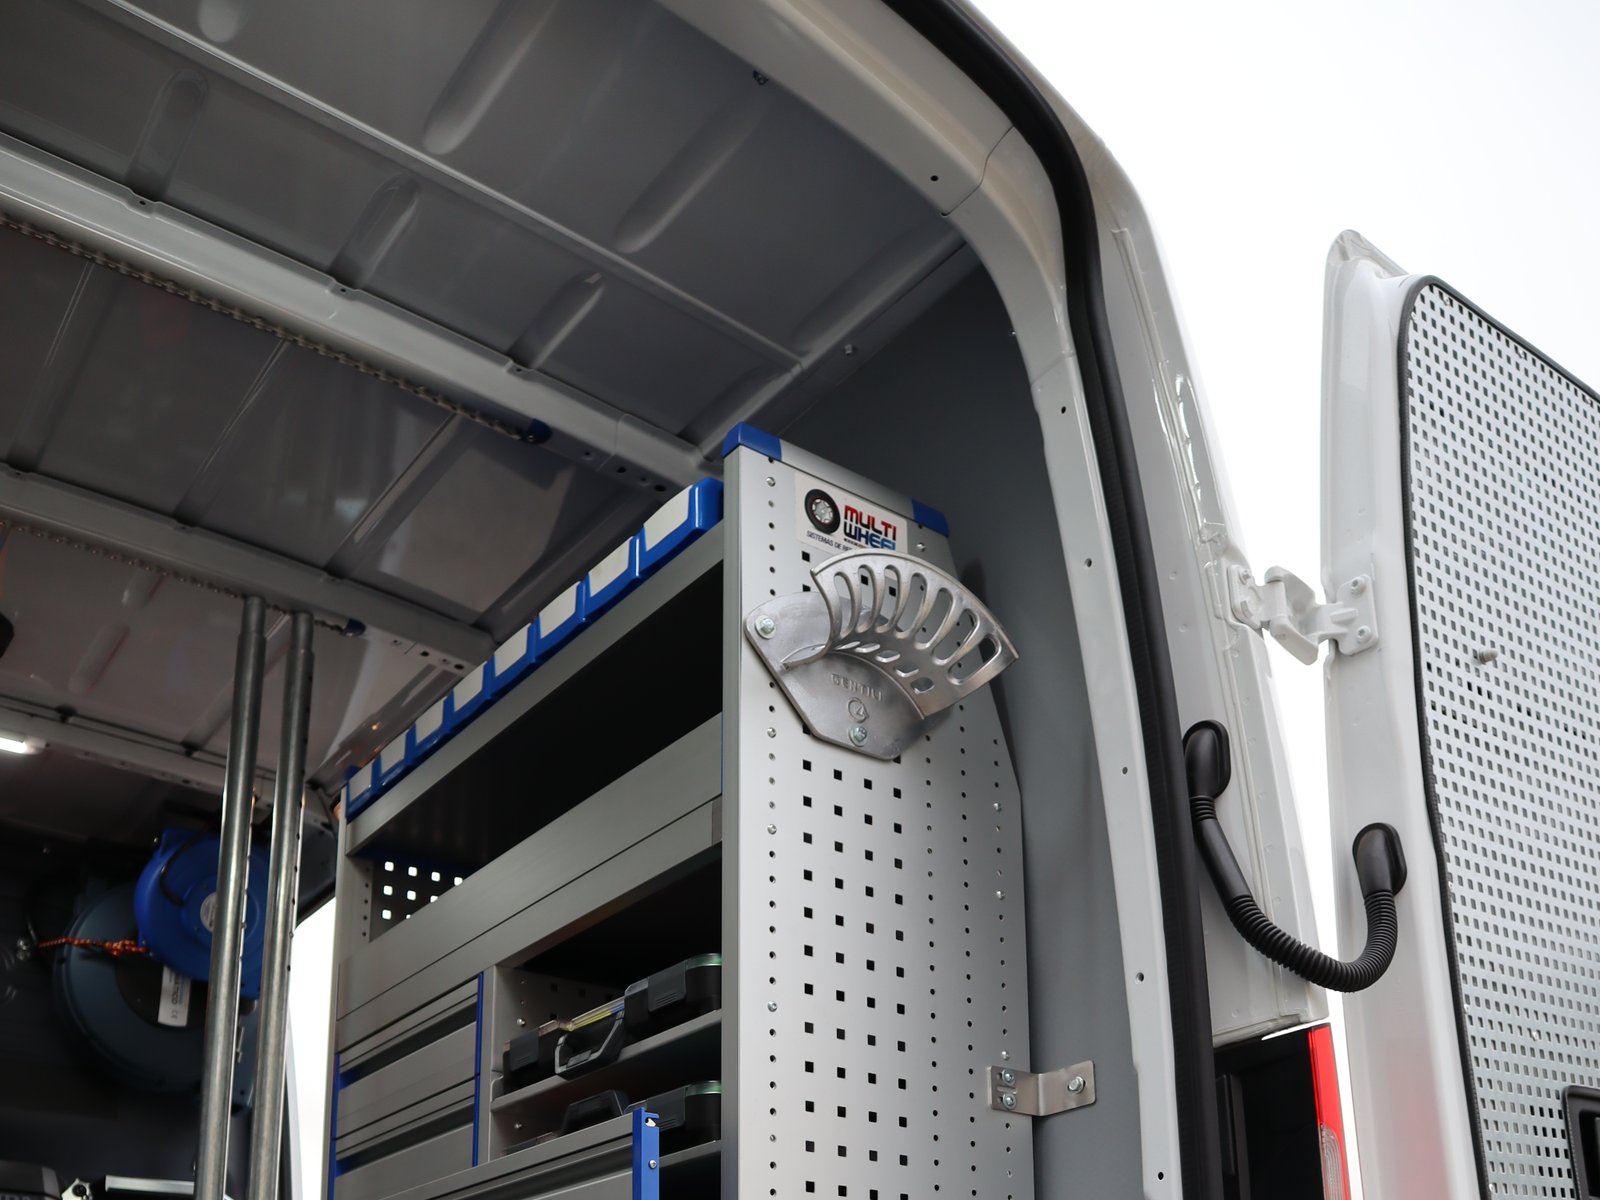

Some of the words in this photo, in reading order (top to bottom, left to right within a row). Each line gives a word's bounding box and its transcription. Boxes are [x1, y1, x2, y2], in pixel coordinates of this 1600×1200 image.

[844, 504, 897, 541] MULTI
[807, 530, 834, 546] SISTEMAS
[834, 541, 842, 550] DE
[831, 673, 882, 701] GENTILI
